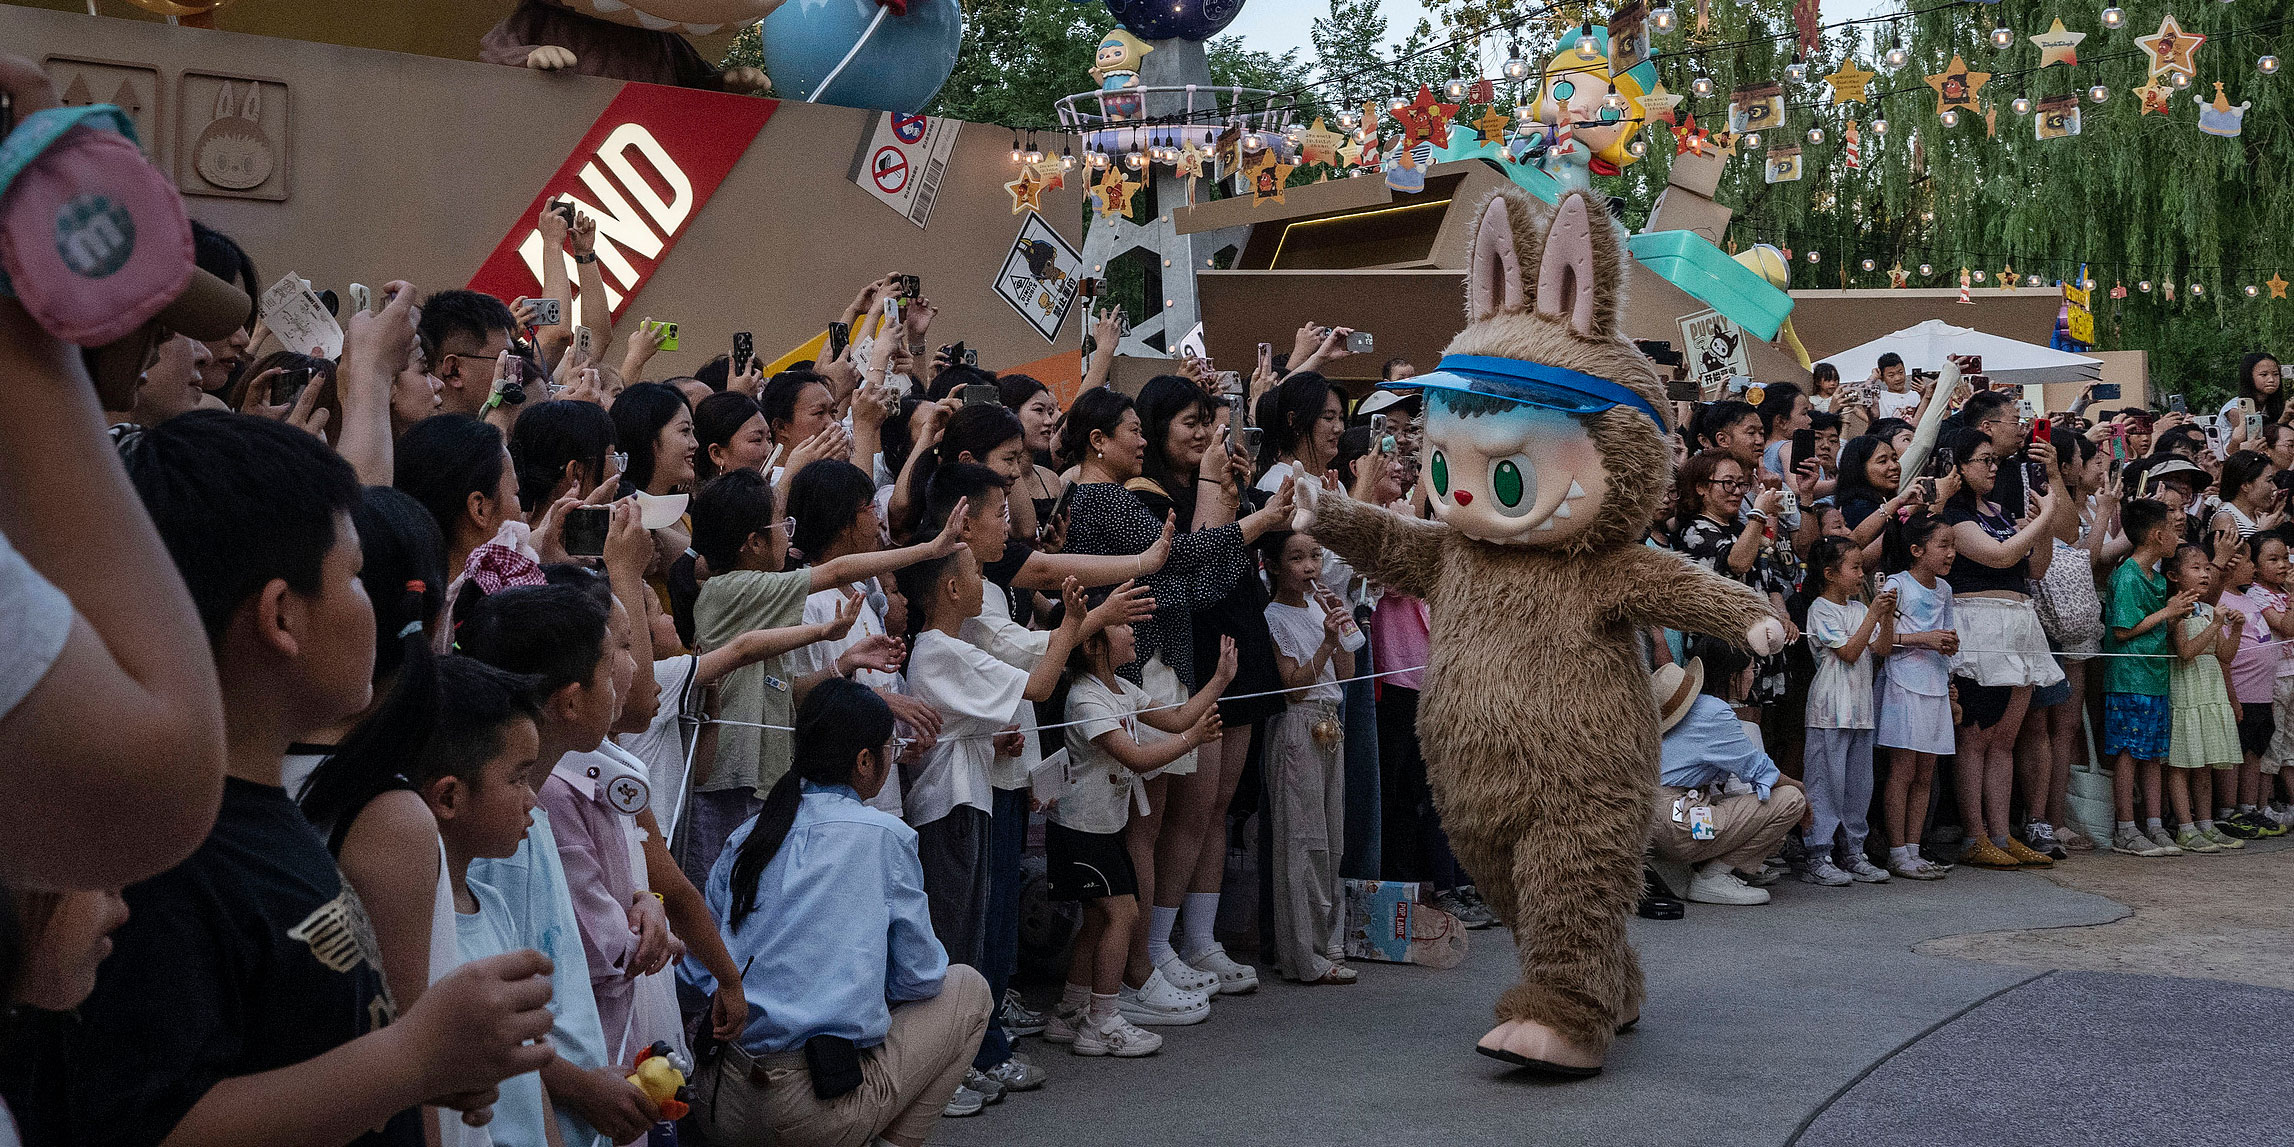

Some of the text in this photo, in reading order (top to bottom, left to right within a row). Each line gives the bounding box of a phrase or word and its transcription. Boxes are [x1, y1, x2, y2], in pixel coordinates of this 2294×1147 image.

[515, 123, 693, 352] AND
[1021, 281, 1033, 302] DIMOO
[1025, 283, 1038, 307] ANUBIS
